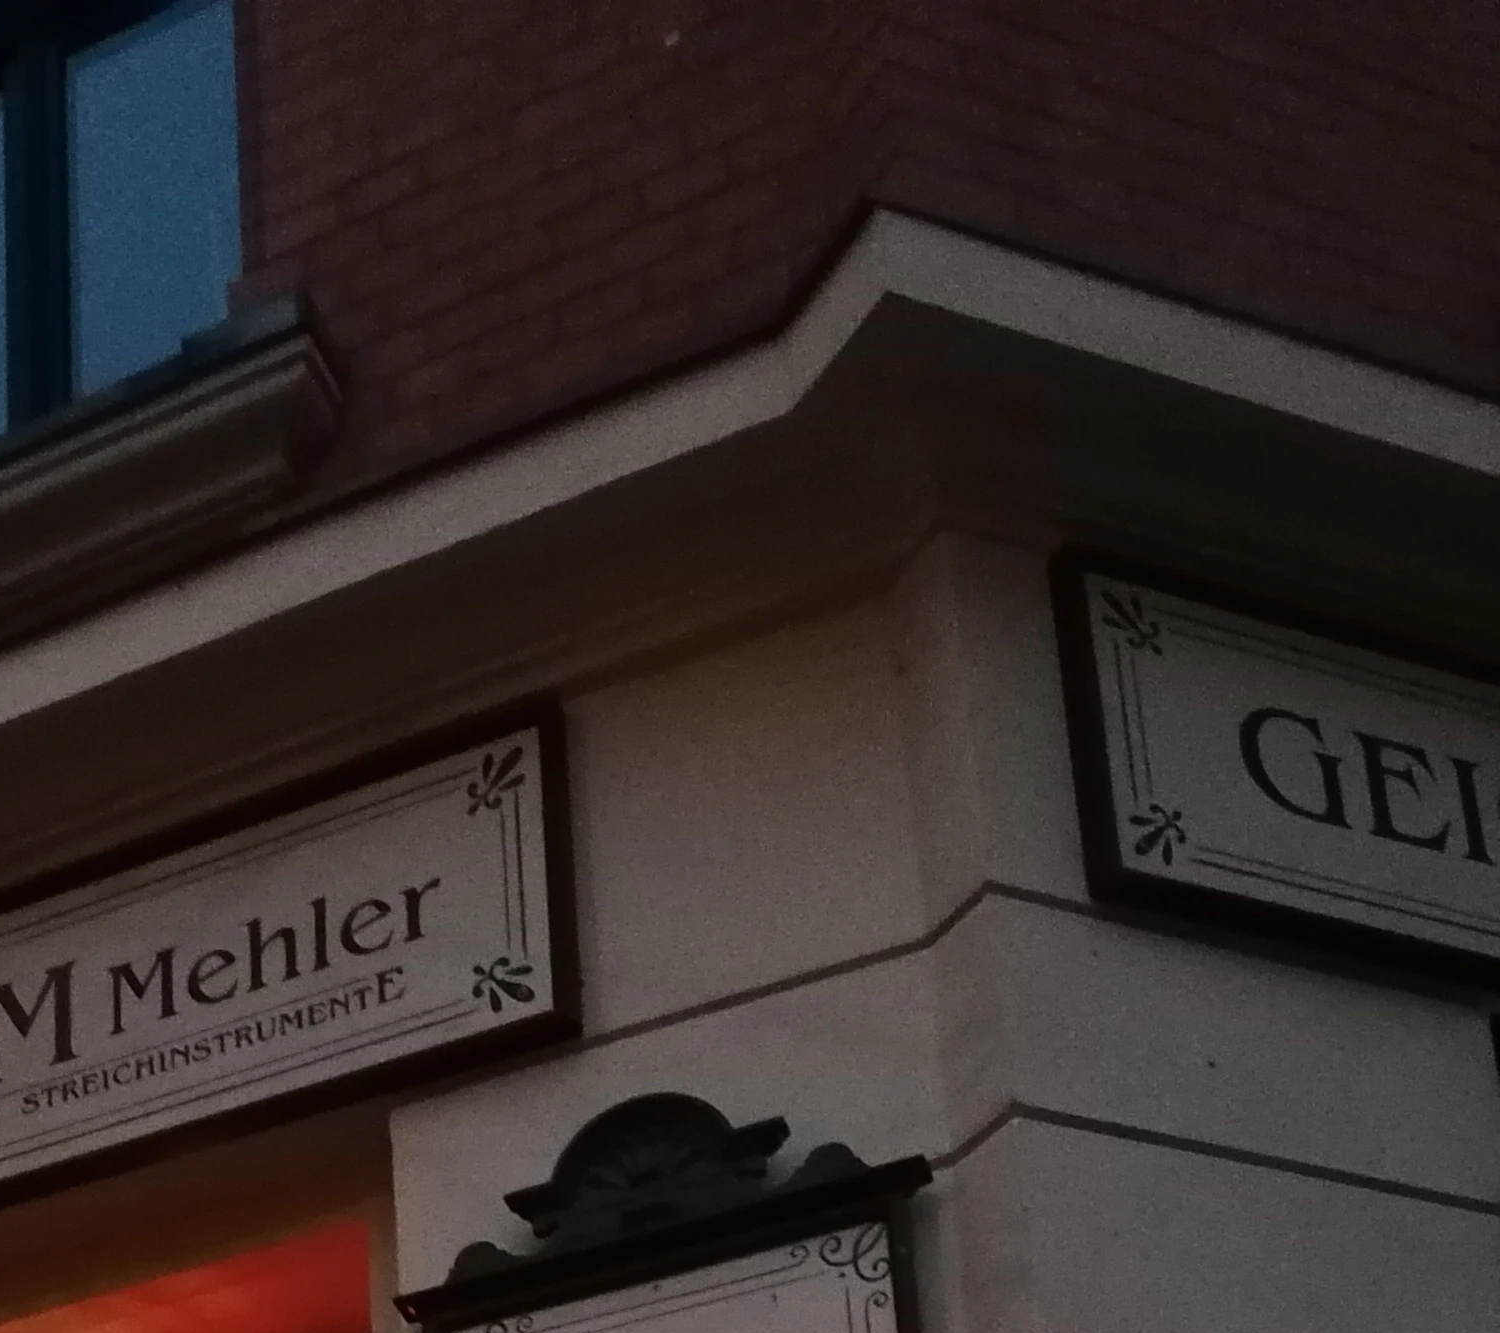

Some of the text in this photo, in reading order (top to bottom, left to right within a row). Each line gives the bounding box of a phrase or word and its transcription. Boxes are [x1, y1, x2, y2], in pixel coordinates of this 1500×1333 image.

[1239, 707, 1500, 867] GEI
[108, 876, 443, 1036] Mehler
[20, 965, 406, 1116] STREICHINSTRUMENTE
